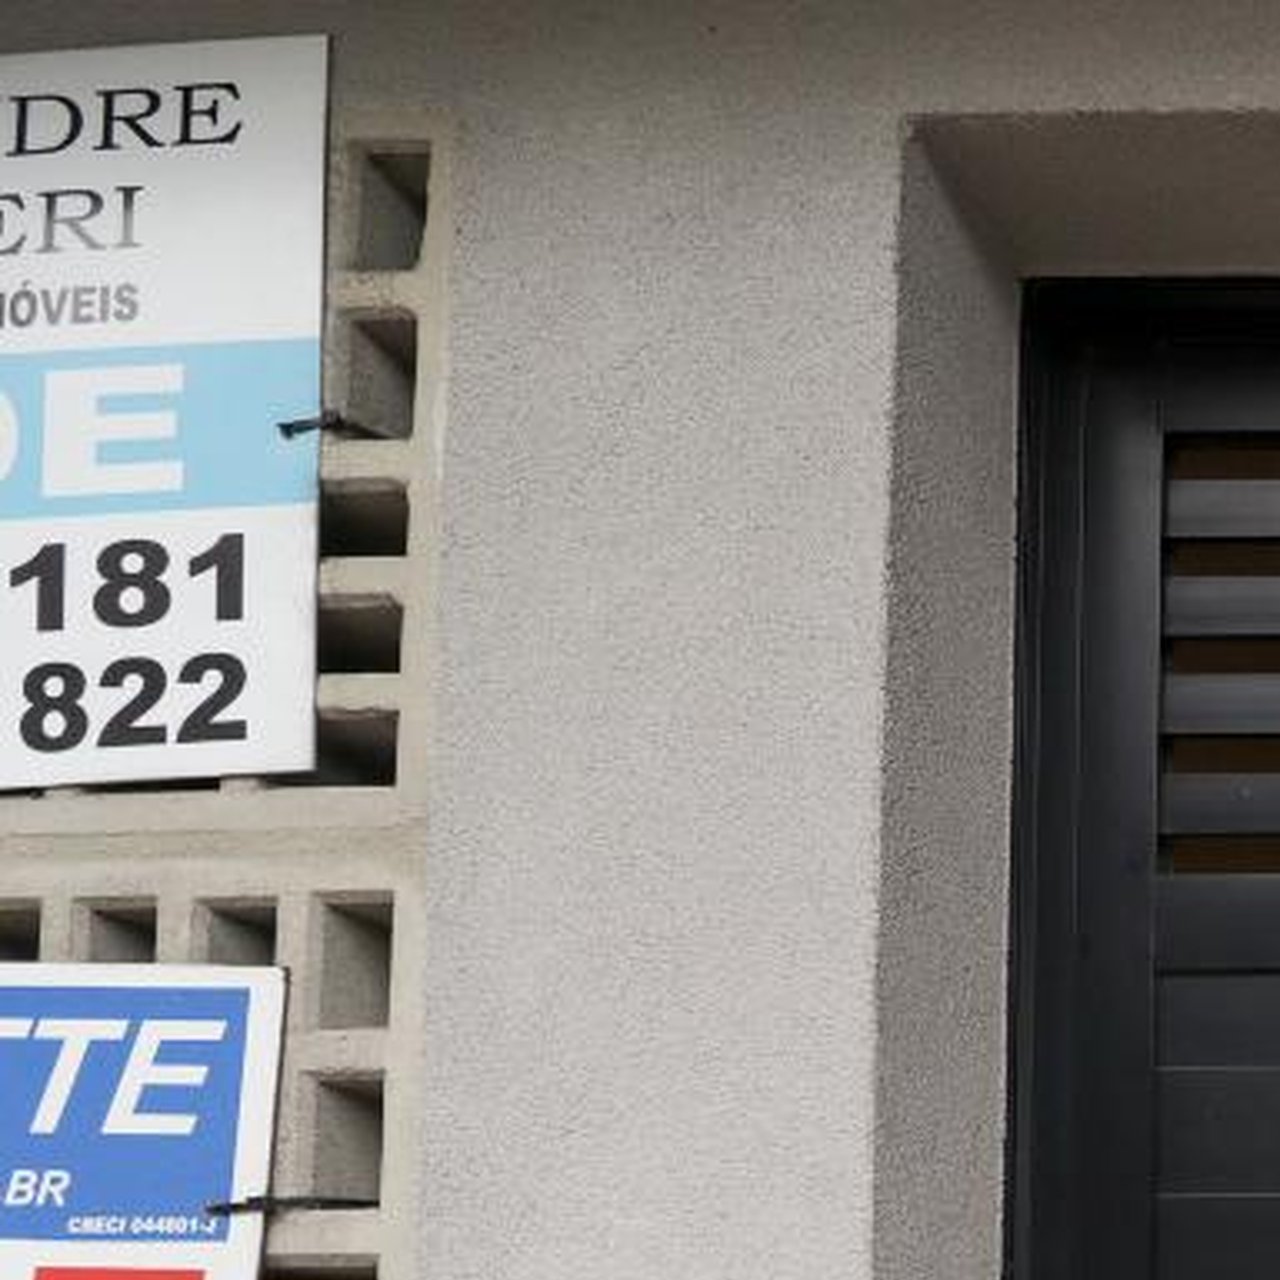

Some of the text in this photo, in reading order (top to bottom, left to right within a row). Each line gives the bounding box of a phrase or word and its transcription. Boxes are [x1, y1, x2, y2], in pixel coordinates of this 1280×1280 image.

[4, 81, 243, 157] DRE
[0, 279, 140, 329] ÓVEIS
[0, 362, 186, 499] E
[9, 532, 245, 633] 181
[18, 652, 248, 754] 822
[4, 1168, 71, 1207] BR
